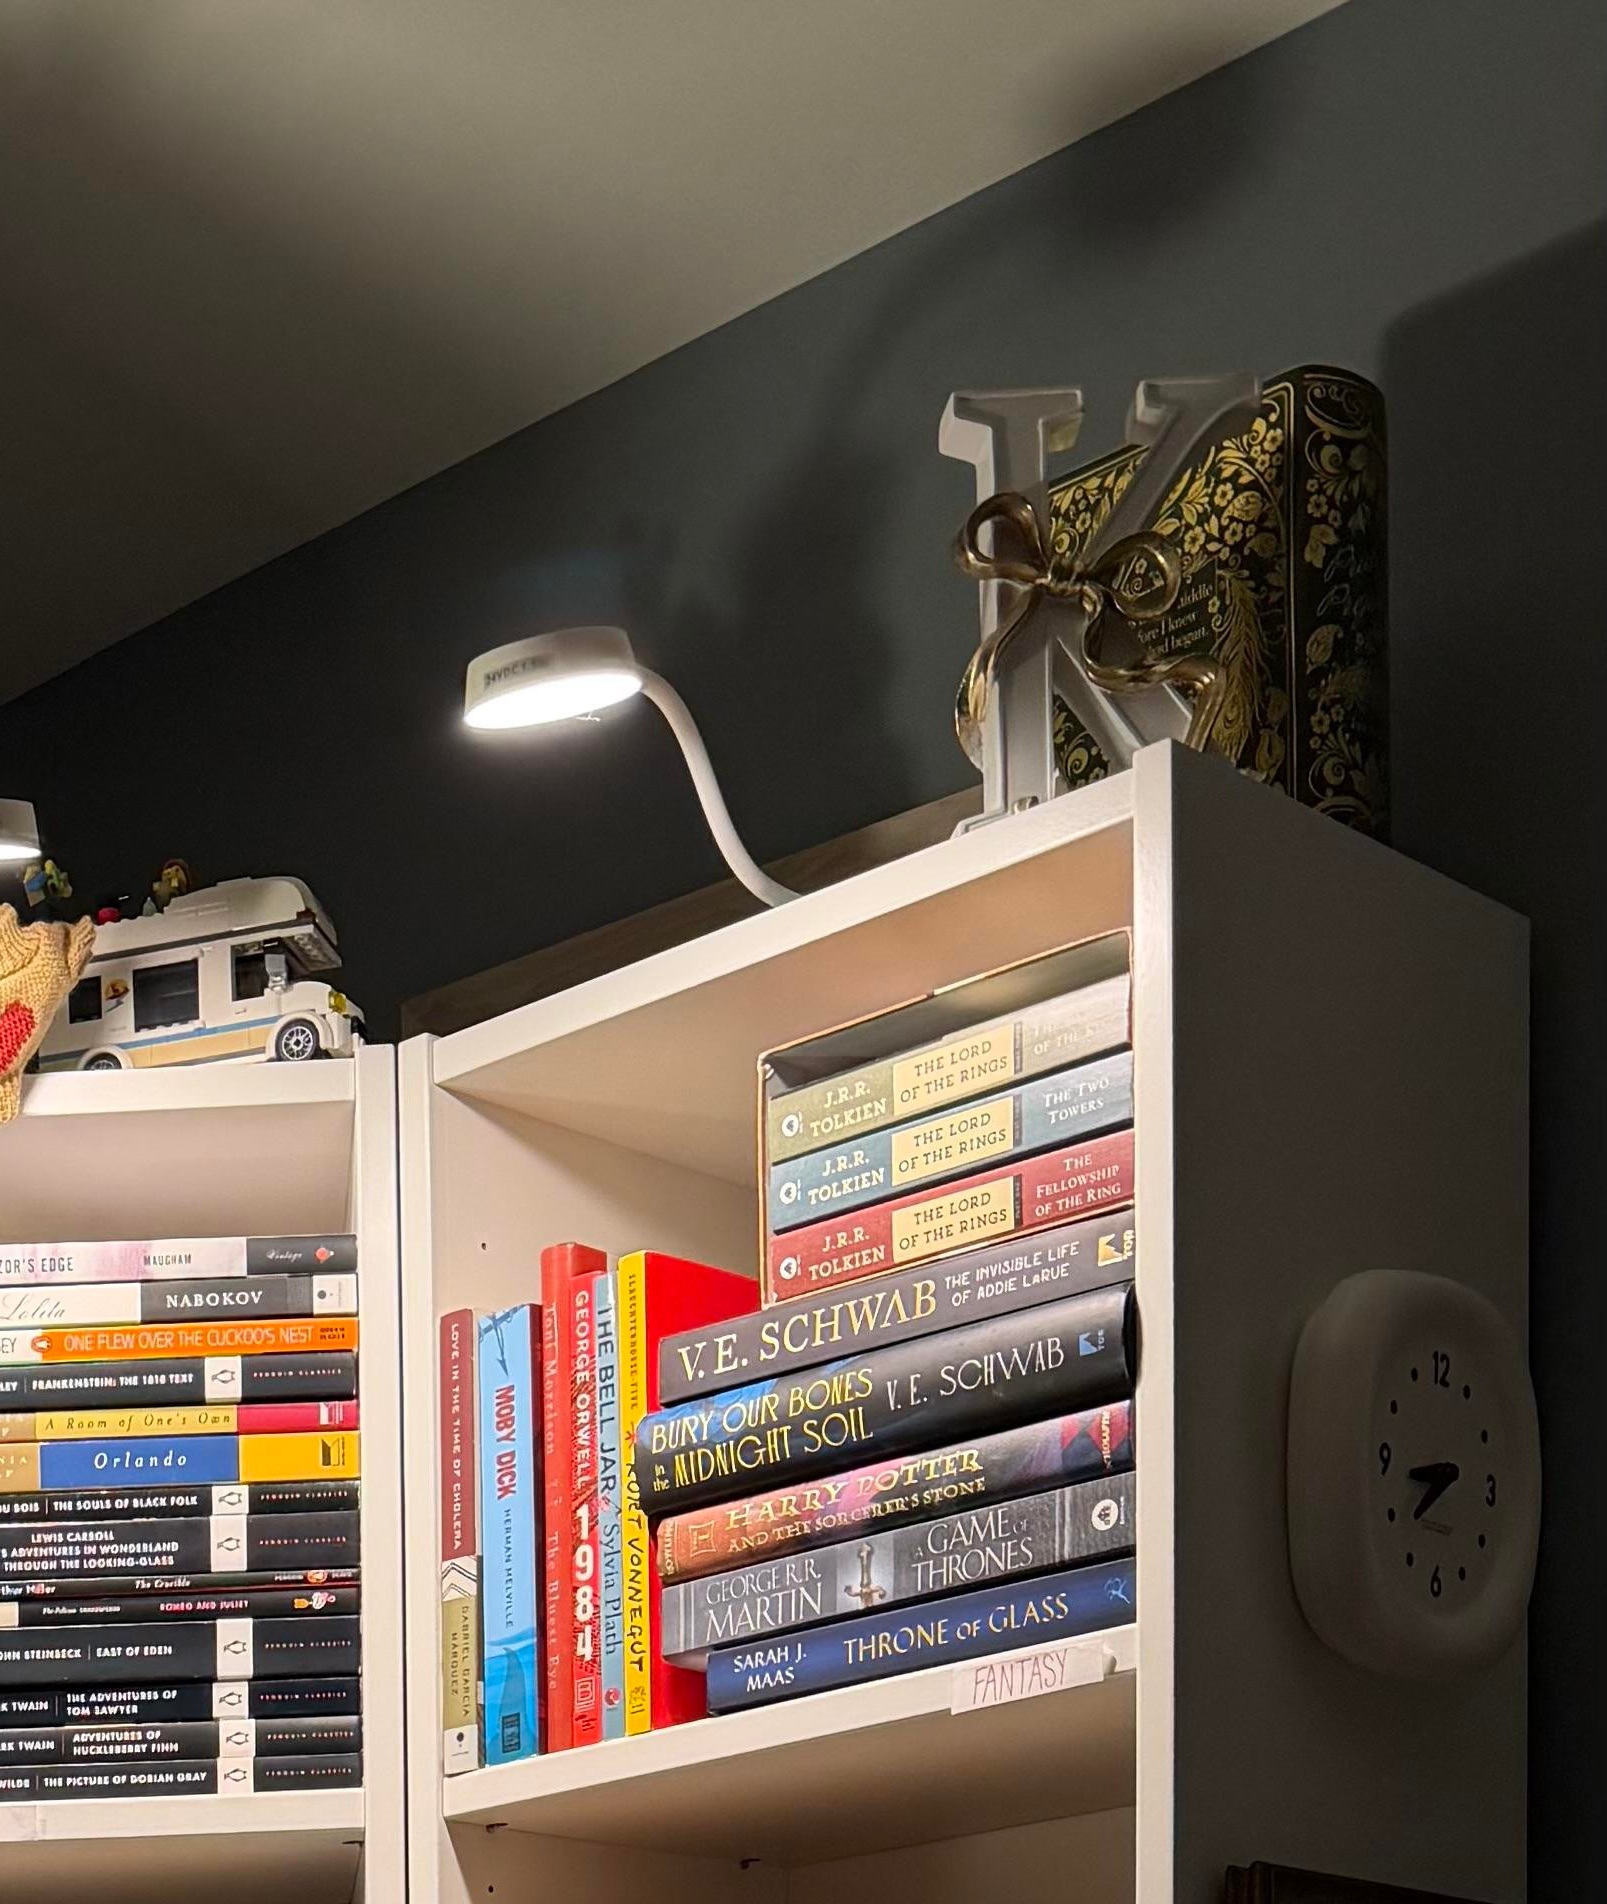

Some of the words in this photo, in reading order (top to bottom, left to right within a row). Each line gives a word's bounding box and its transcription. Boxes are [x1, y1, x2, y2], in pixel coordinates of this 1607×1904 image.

[41, 1256, 74, 1272] EDGE
[166, 1291, 262, 1308] NABOKOV
[759, 1280, 937, 1365] SCHWAB
[1432, 1350, 1450, 1388] 12
[494, 1385, 516, 1445] MOBY
[94, 1450, 187, 1470] Orlando
[496, 1451, 517, 1500] DICK
[1379, 1442, 1392, 1475] 9
[1485, 1474, 1497, 1507] 3
[573, 1504, 594, 1661] 1984
[1430, 1565, 1442, 1598] 6
[844, 1621, 949, 1665] THRONE
[957, 1618, 982, 1640] OF
[988, 1594, 1069, 1634] GLASS
[973, 1648, 1069, 1705] FANTASY
